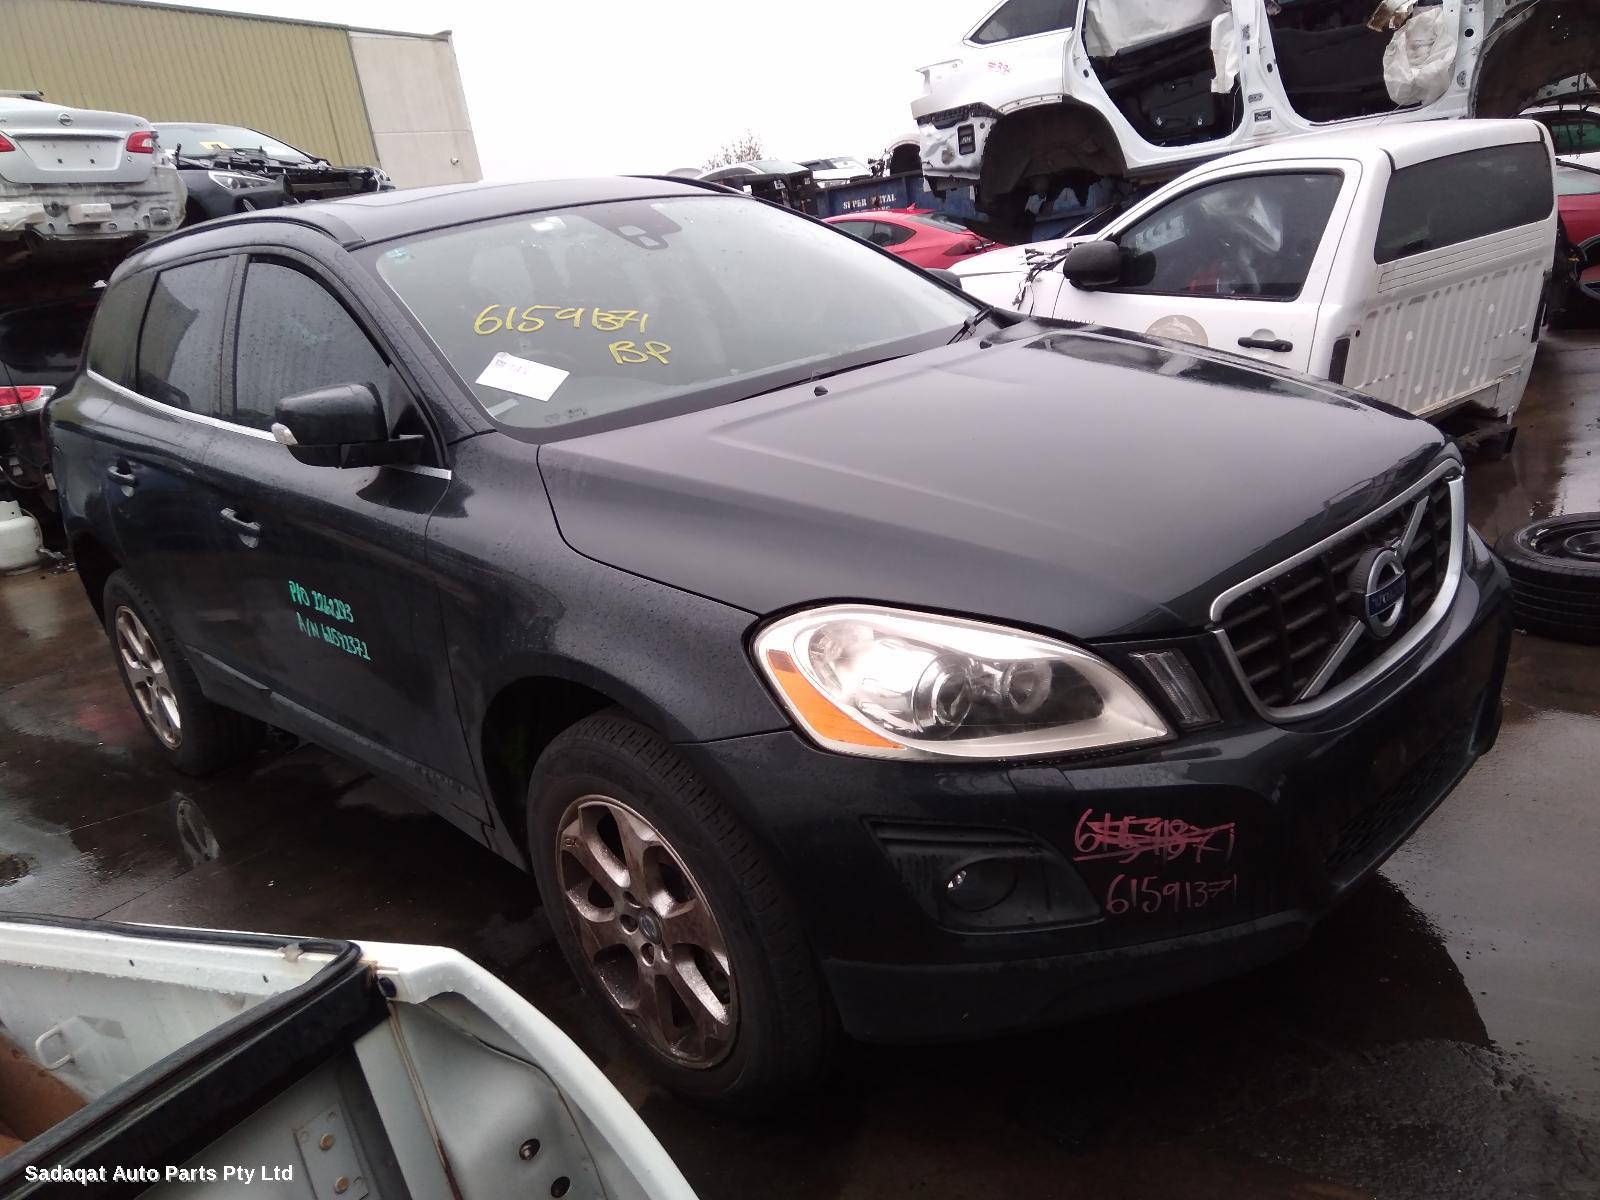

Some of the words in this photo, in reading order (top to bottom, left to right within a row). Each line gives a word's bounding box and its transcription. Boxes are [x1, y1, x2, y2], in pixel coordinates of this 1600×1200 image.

[473, 303, 648, 335] 61591371
[608, 340, 671, 365] BP
[1106, 873, 1237, 914] 61591371
